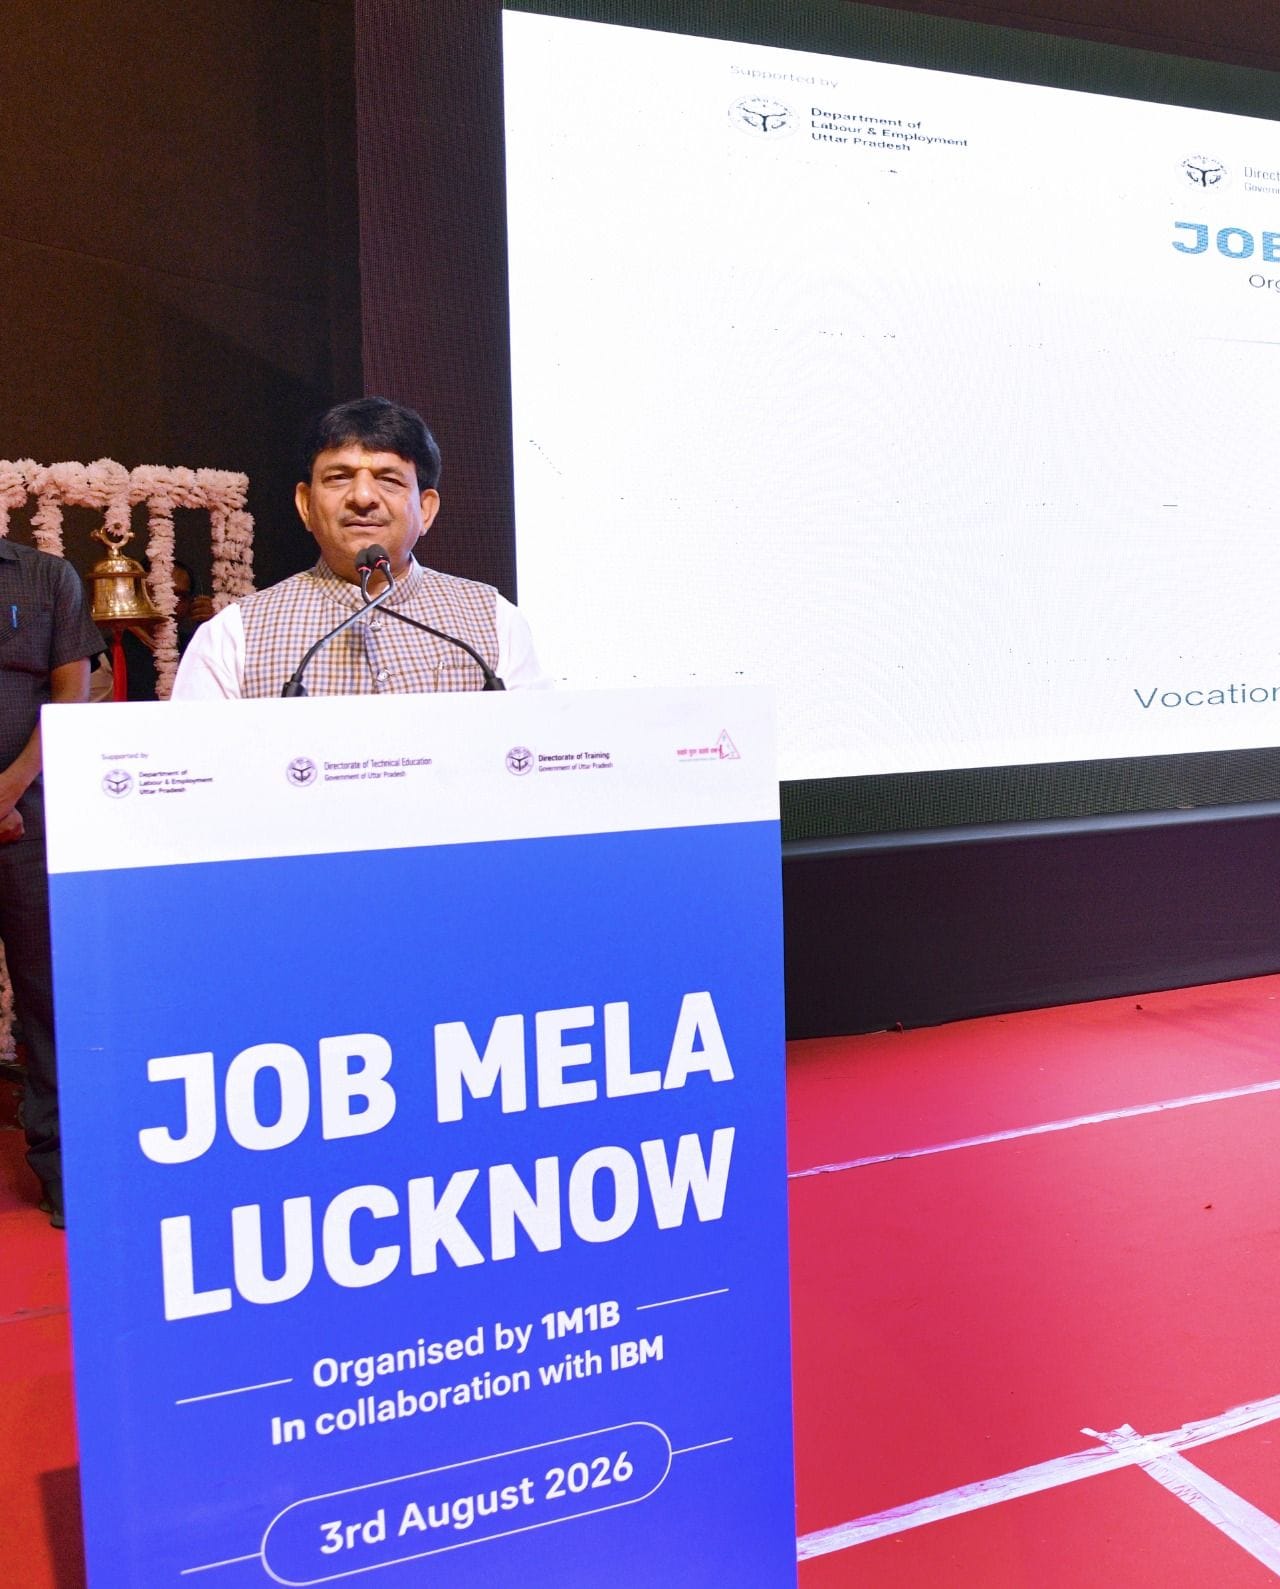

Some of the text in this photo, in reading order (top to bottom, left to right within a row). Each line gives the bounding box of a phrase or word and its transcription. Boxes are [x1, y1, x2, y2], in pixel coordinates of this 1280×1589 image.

[811, 106, 922, 130] Department of
[811, 120, 968, 148] Labour & Employment
[811, 132, 911, 152] Uttar Pradesh
[324, 757, 432, 770] Directorate of Technical Education
[538, 751, 610, 762] Directorate of Training
[139, 770, 179, 778] Department
[324, 773, 359, 781] Government
[384, 770, 406, 778] Pradesh
[138, 991, 735, 1165] JOB MELA
[160, 1126, 736, 1321] LUCKNOW
[313, 1300, 621, 1389] Organised by 1M1B
[270, 1334, 665, 1446] In collaboration with IBM
[319, 1450, 634, 1556] 3rd August 2026
